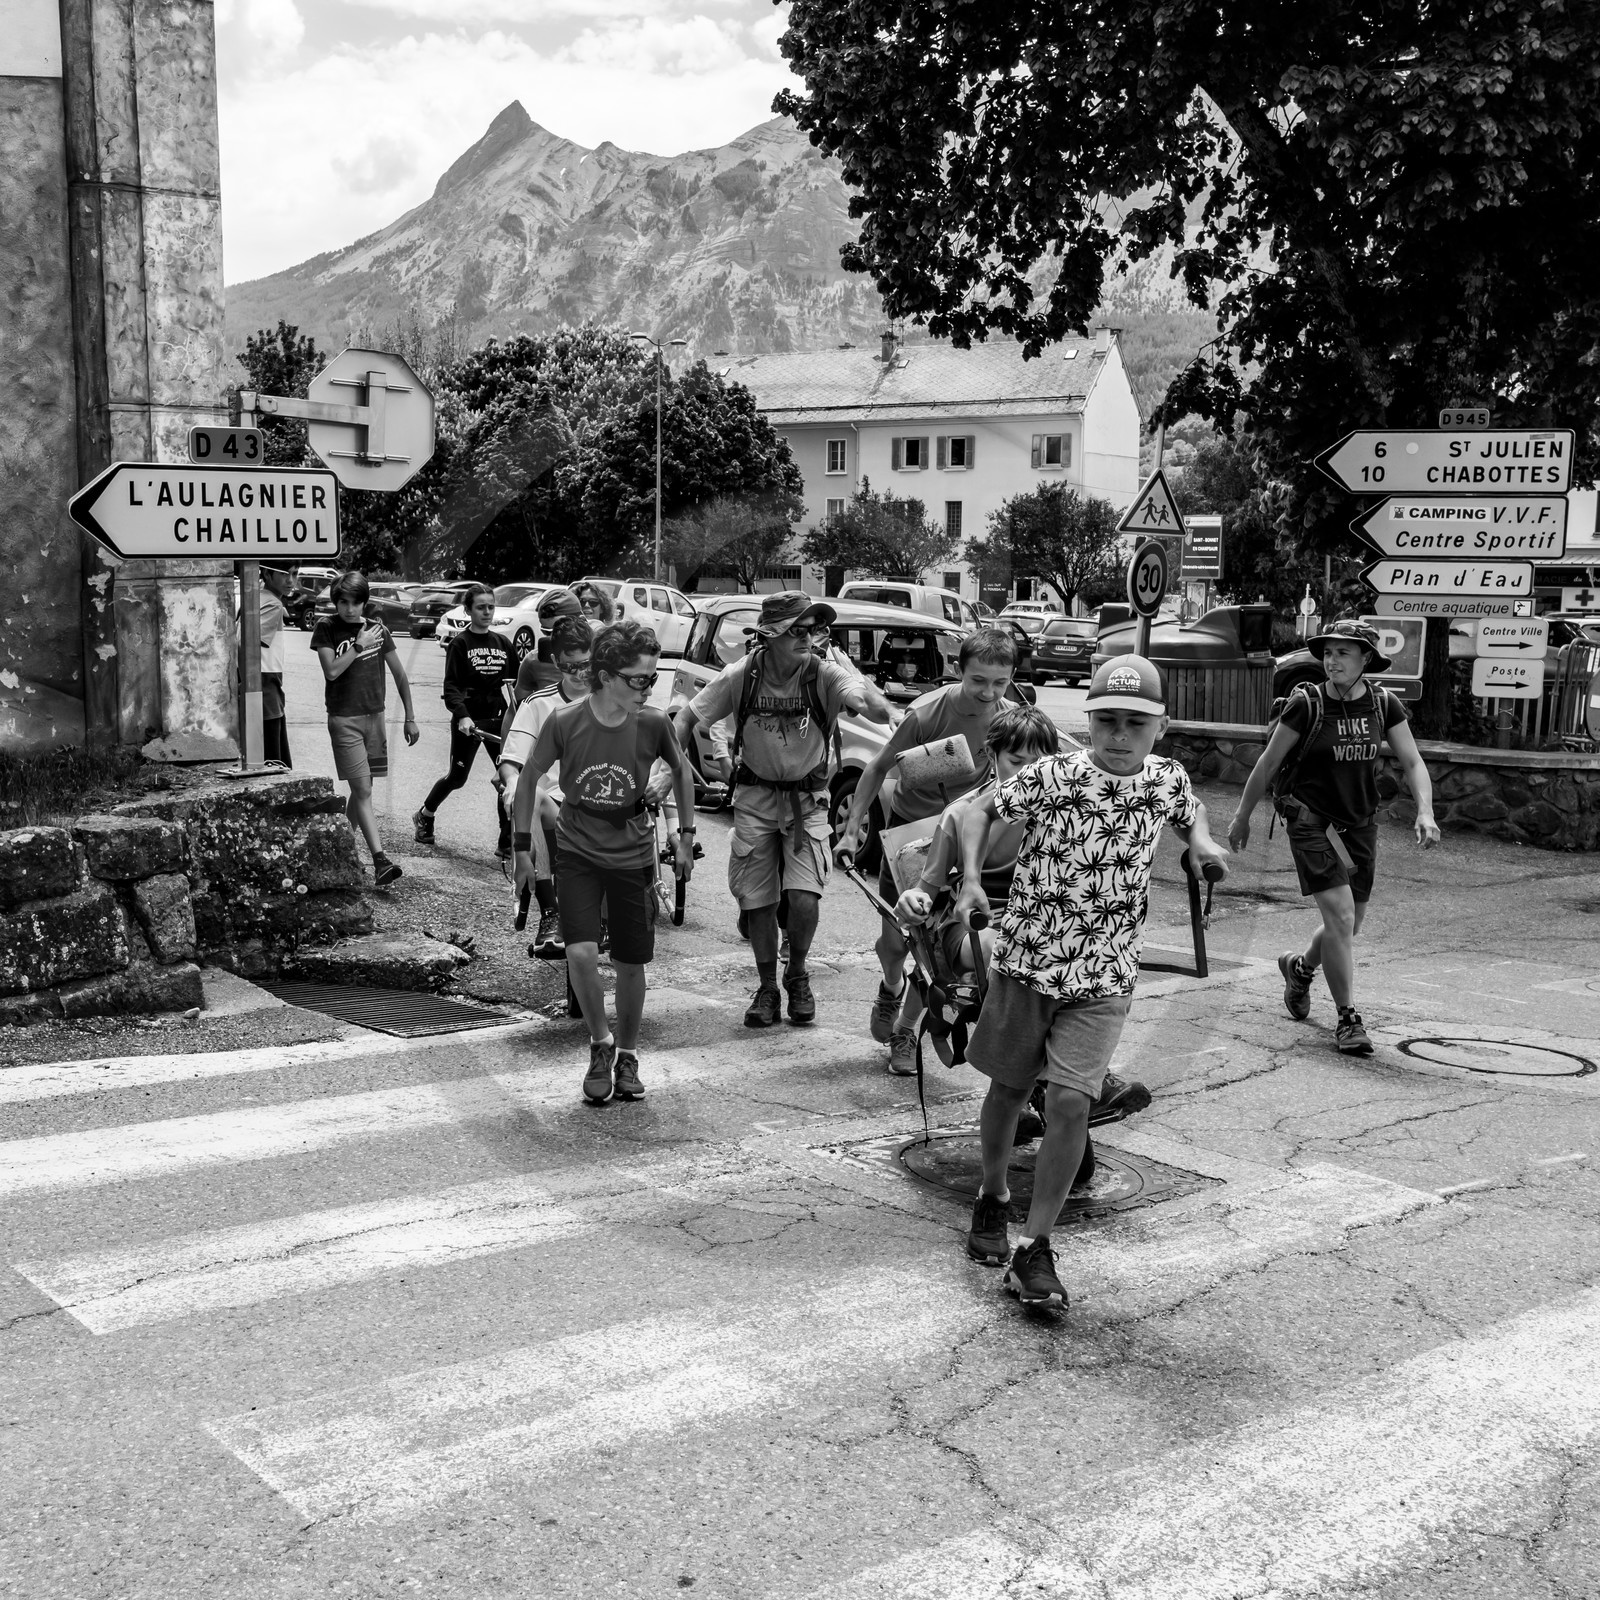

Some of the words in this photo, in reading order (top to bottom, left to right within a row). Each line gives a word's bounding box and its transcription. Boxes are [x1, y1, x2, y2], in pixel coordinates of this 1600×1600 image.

[1443, 413, 1452, 425] D
[1456, 413, 1486, 425] 945
[195, 432, 212, 458] D
[222, 433, 259, 459] 43
[1374, 441, 1388, 459] 6
[1480, 440, 1563, 459] JULIEN
[1361, 465, 1386, 483] 10
[1426, 465, 1560, 483] CHABOTTES
[128, 480, 328, 510] L'AULAGNIER
[1409, 507, 1487, 520] CAMPING
[1493, 506, 1557, 524] V.V.F.
[173, 517, 328, 543] CHAILLOL
[1395, 530, 1465, 548] Centre
[1473, 531, 1557, 551] Sportif
[1138, 563, 1161, 594] 30
[1389, 568, 1440, 586] Plan
[1393, 599, 1438, 612] Centre
[1441, 601, 1510, 617] aquatique
[1482, 626, 1517, 636] Centre
[1520, 626, 1543, 636] Ville
[1491, 666, 1526, 676] Poste
[1107, 678, 1141, 687] PICTURE
[1337, 717, 1370, 736] HIKE
[1332, 743, 1378, 761] WORLD
[575, 762, 609, 785] CHAMPSAUR
[609, 764, 628, 776] JUDO
[626, 773, 637, 790] CLUB
